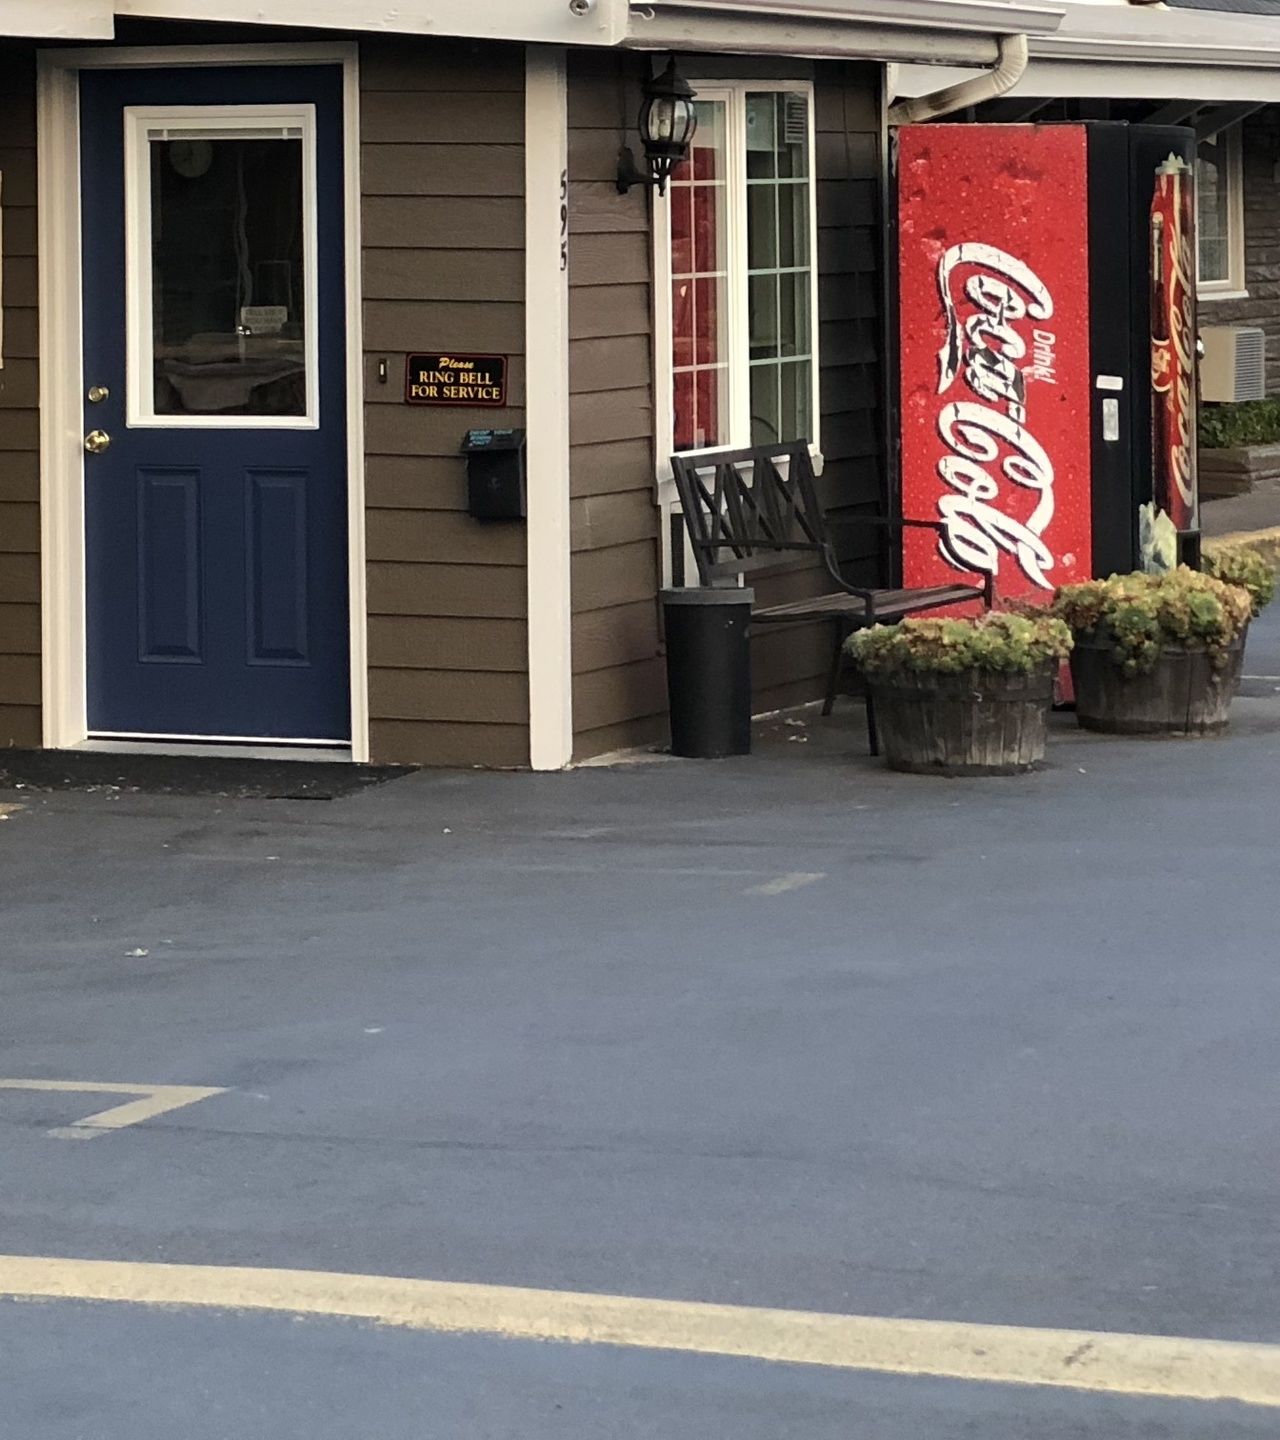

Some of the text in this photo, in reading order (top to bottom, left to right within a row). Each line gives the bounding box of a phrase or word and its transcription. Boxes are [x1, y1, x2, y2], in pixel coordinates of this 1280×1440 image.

[559, 168, 568, 272] 595
[439, 357, 474, 369] Please
[419, 371, 493, 385] RING BELL
[411, 384, 500, 399] FOR SERVICE
